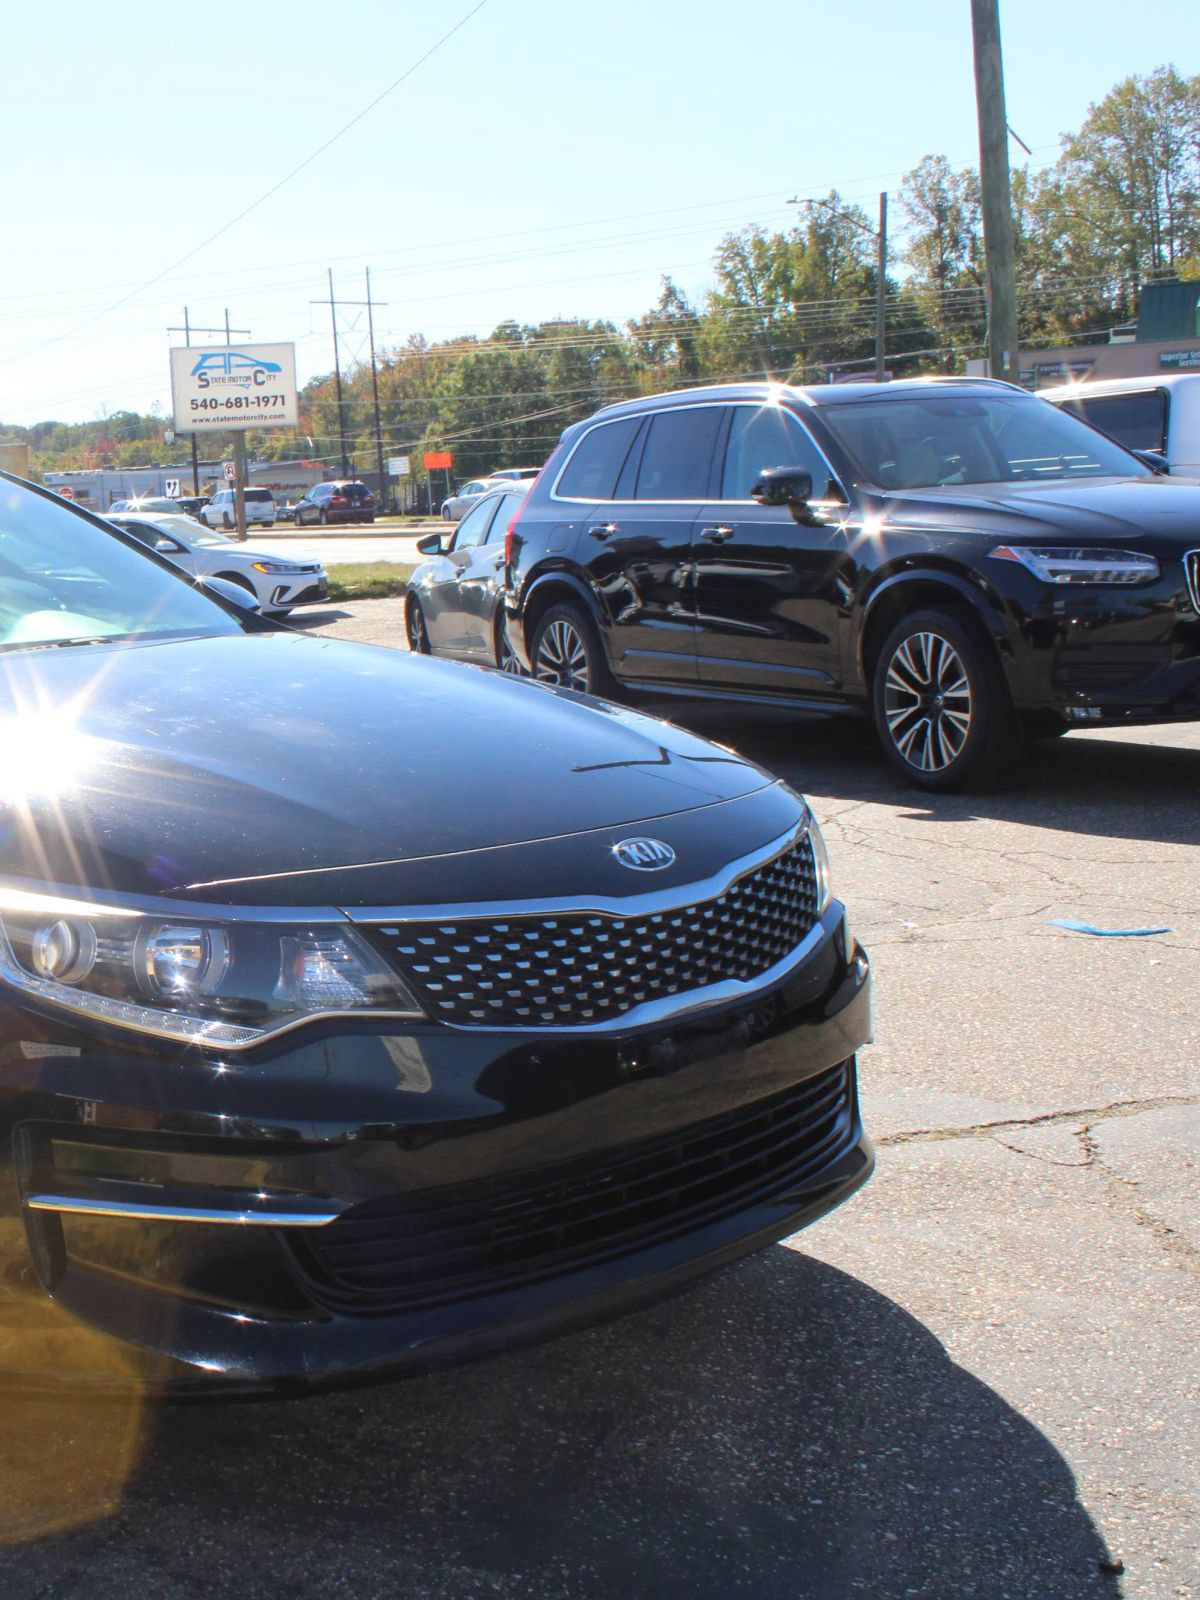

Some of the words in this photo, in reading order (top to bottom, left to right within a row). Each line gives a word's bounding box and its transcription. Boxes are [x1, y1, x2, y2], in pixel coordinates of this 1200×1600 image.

[253, 369, 277, 386] CITY
[190, 395, 286, 411] 540-681-1971
[191, 413, 286, 424] www.statemotorcity.com
[622, 841, 672, 865] KIA
